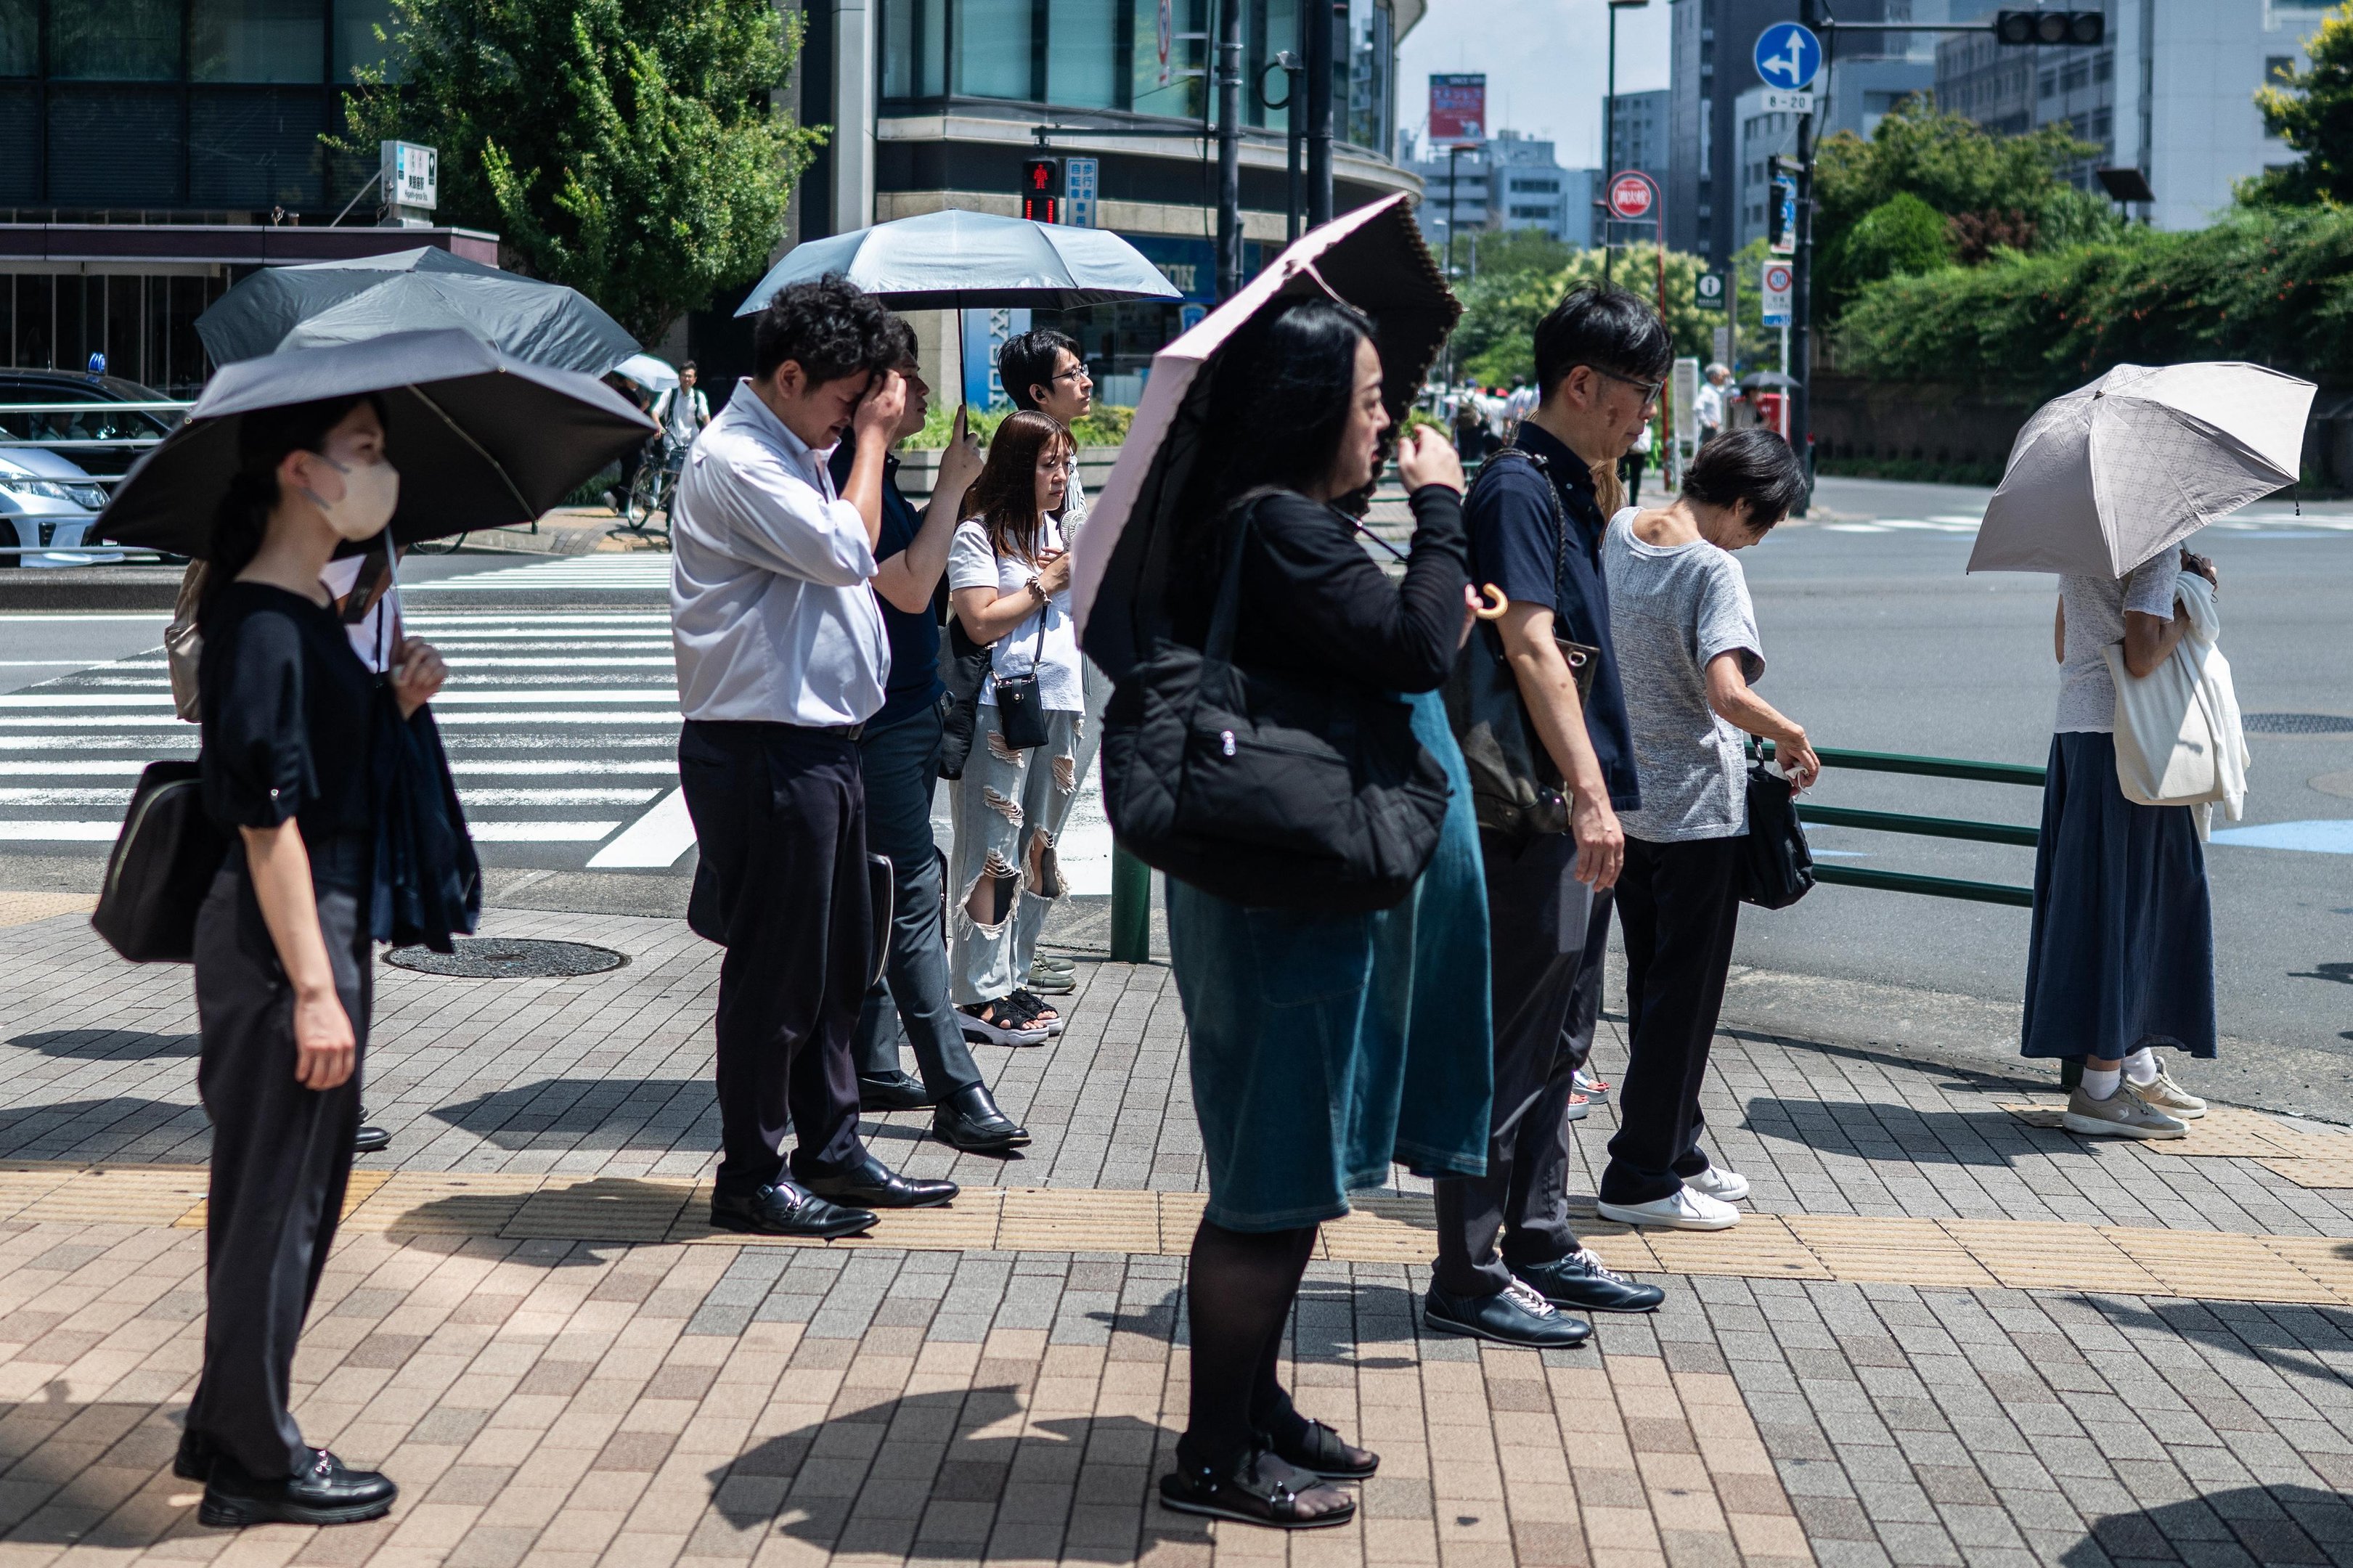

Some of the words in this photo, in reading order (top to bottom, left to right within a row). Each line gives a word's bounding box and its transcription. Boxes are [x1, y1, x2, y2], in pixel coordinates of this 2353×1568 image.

[1071, 163, 1081, 199] 自転車
[1082, 163, 1093, 200] 歩行者
[1772, 273, 1786, 286] 30
